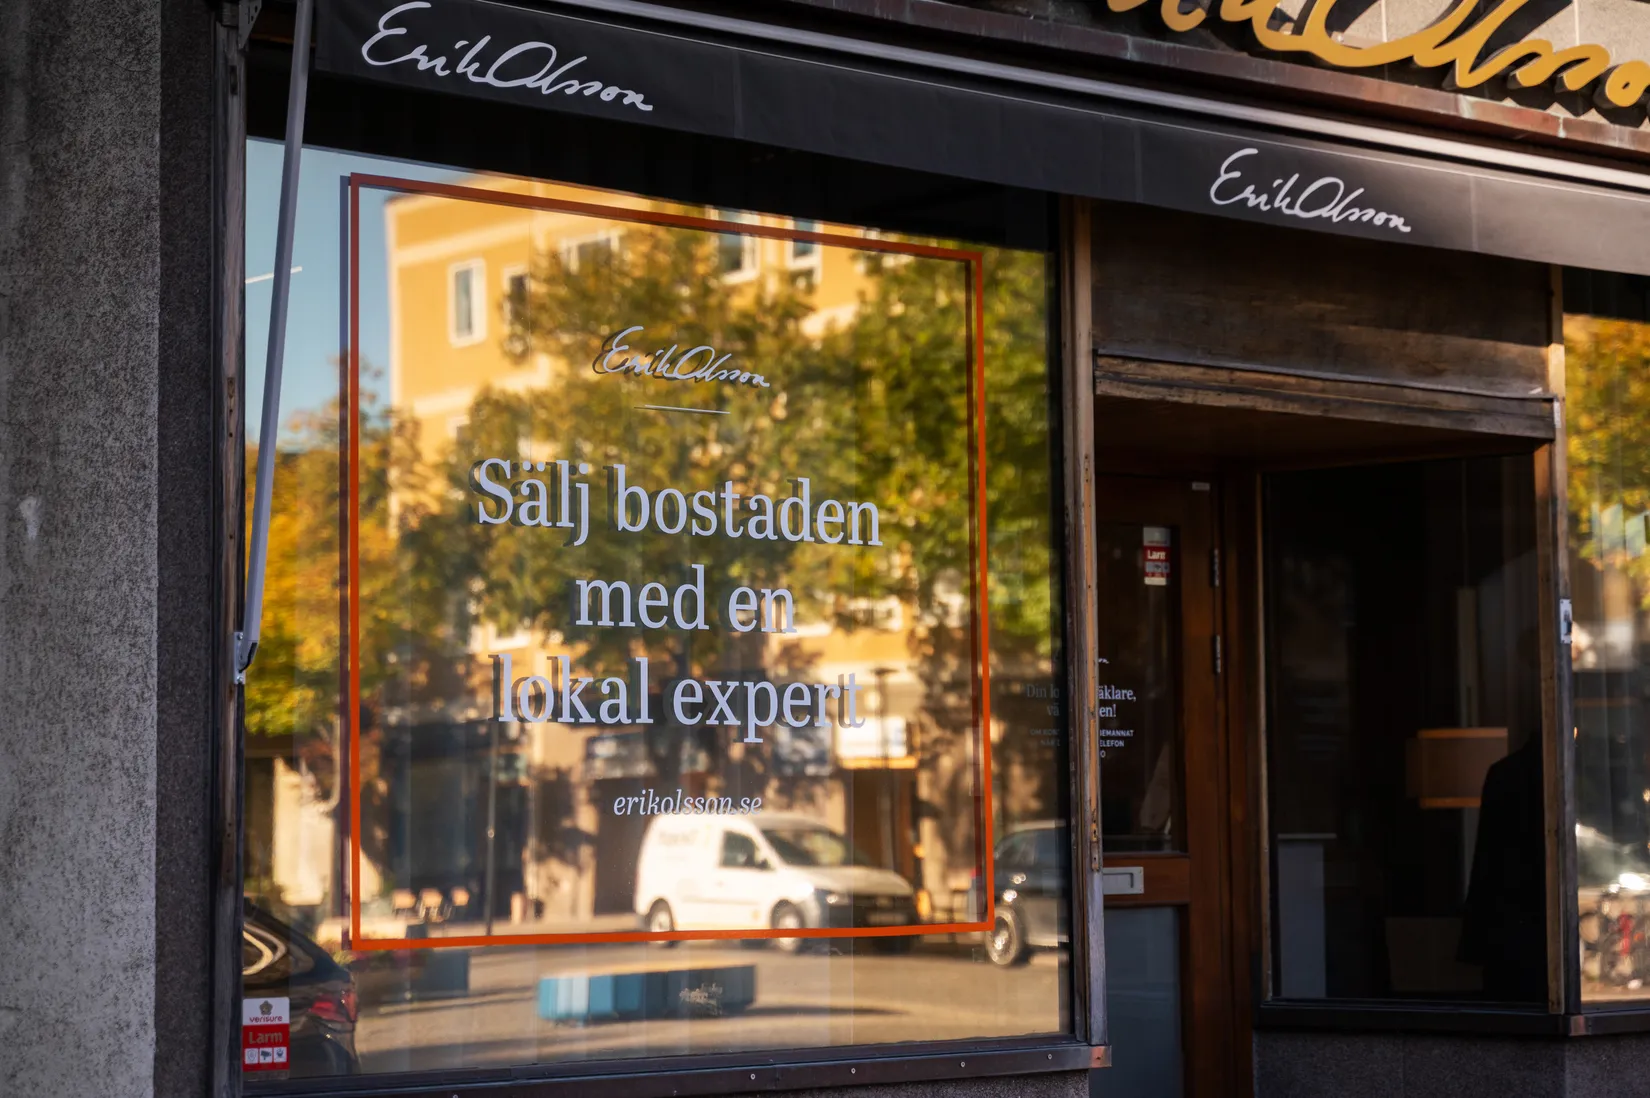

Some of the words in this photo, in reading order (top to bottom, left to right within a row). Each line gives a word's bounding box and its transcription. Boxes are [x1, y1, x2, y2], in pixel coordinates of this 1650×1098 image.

[476, 457, 590, 546] Sälj
[614, 463, 883, 546] bostaden
[575, 563, 710, 631] med
[728, 585, 798, 634] en
[497, 653, 655, 725] lokal
[673, 672, 866, 743] expert
[613, 787, 763, 816] erikolsson.se
[248, 1031, 283, 1045] Larm
[249, 1014, 283, 1023] verisure
